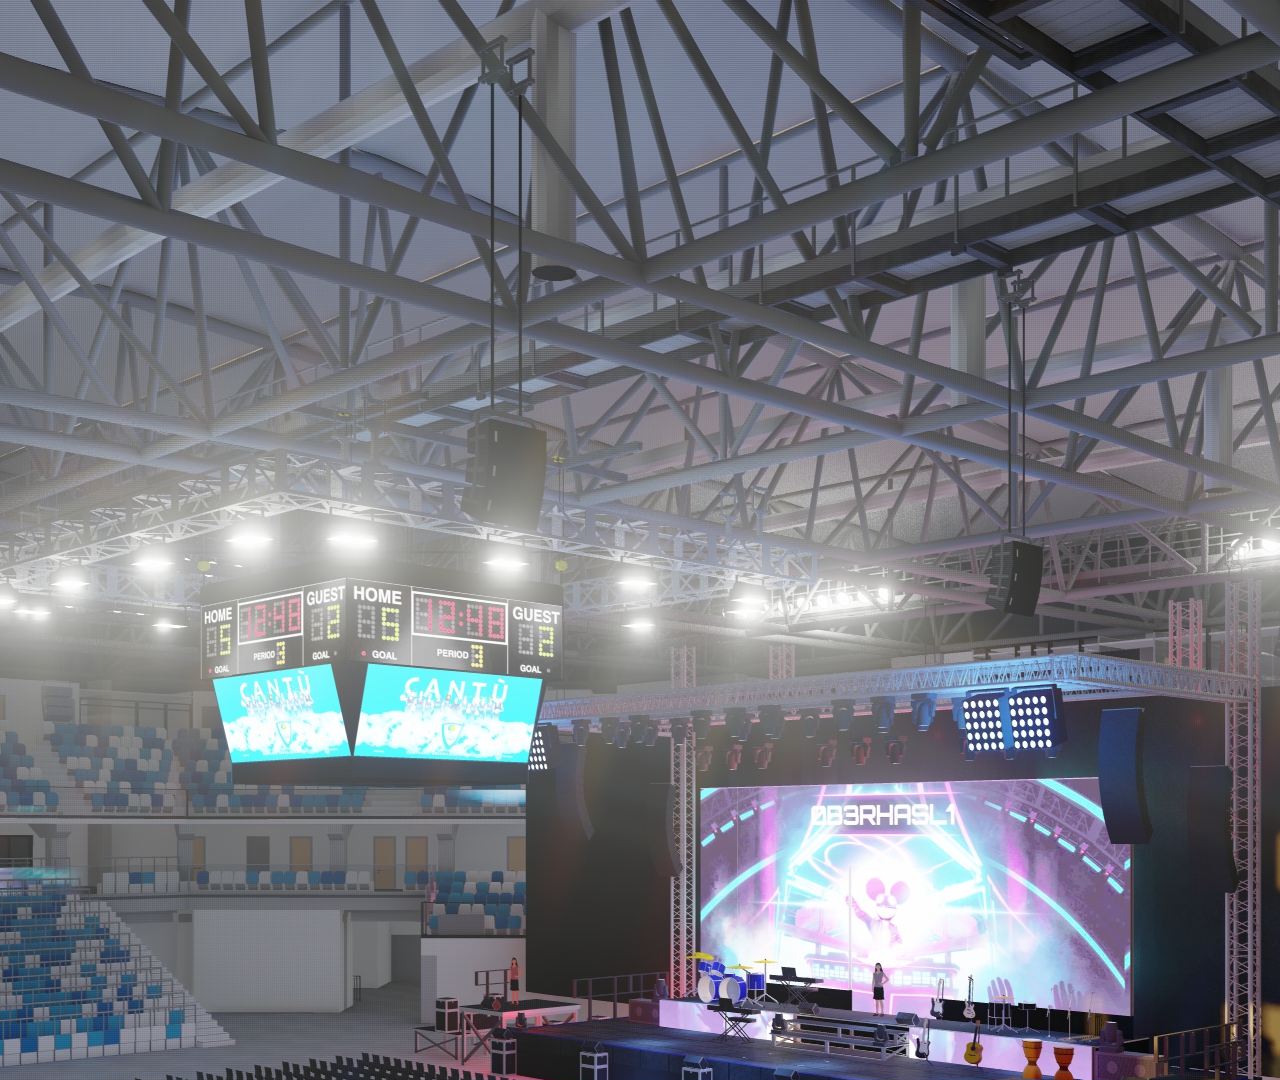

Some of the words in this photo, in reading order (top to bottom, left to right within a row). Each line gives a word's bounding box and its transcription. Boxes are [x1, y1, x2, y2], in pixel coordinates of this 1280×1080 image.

[306, 585, 346, 606] GUEST
[353, 585, 402, 605] HOME
[204, 607, 233, 625] HOME
[247, 597, 301, 639] 12:48
[327, 604, 340, 640] 2
[381, 606, 400, 642] 5
[427, 598, 505, 640] 12:48
[512, 606, 561, 625] GUEST
[220, 623, 231, 656] 5
[538, 625, 554, 658] 2
[253, 650, 276, 661] PERIOD
[276, 641, 286, 665] 3
[312, 650, 330, 660] GOAL
[371, 650, 398, 661] GOAL
[436, 648, 469, 660] PERIOD
[470, 644, 484, 669] 3
[214, 664, 230, 674] GOAL
[519, 664, 542, 674] GOAL
[240, 670, 311, 702] CANTÙ
[404, 676, 509, 704] CANTÙ
